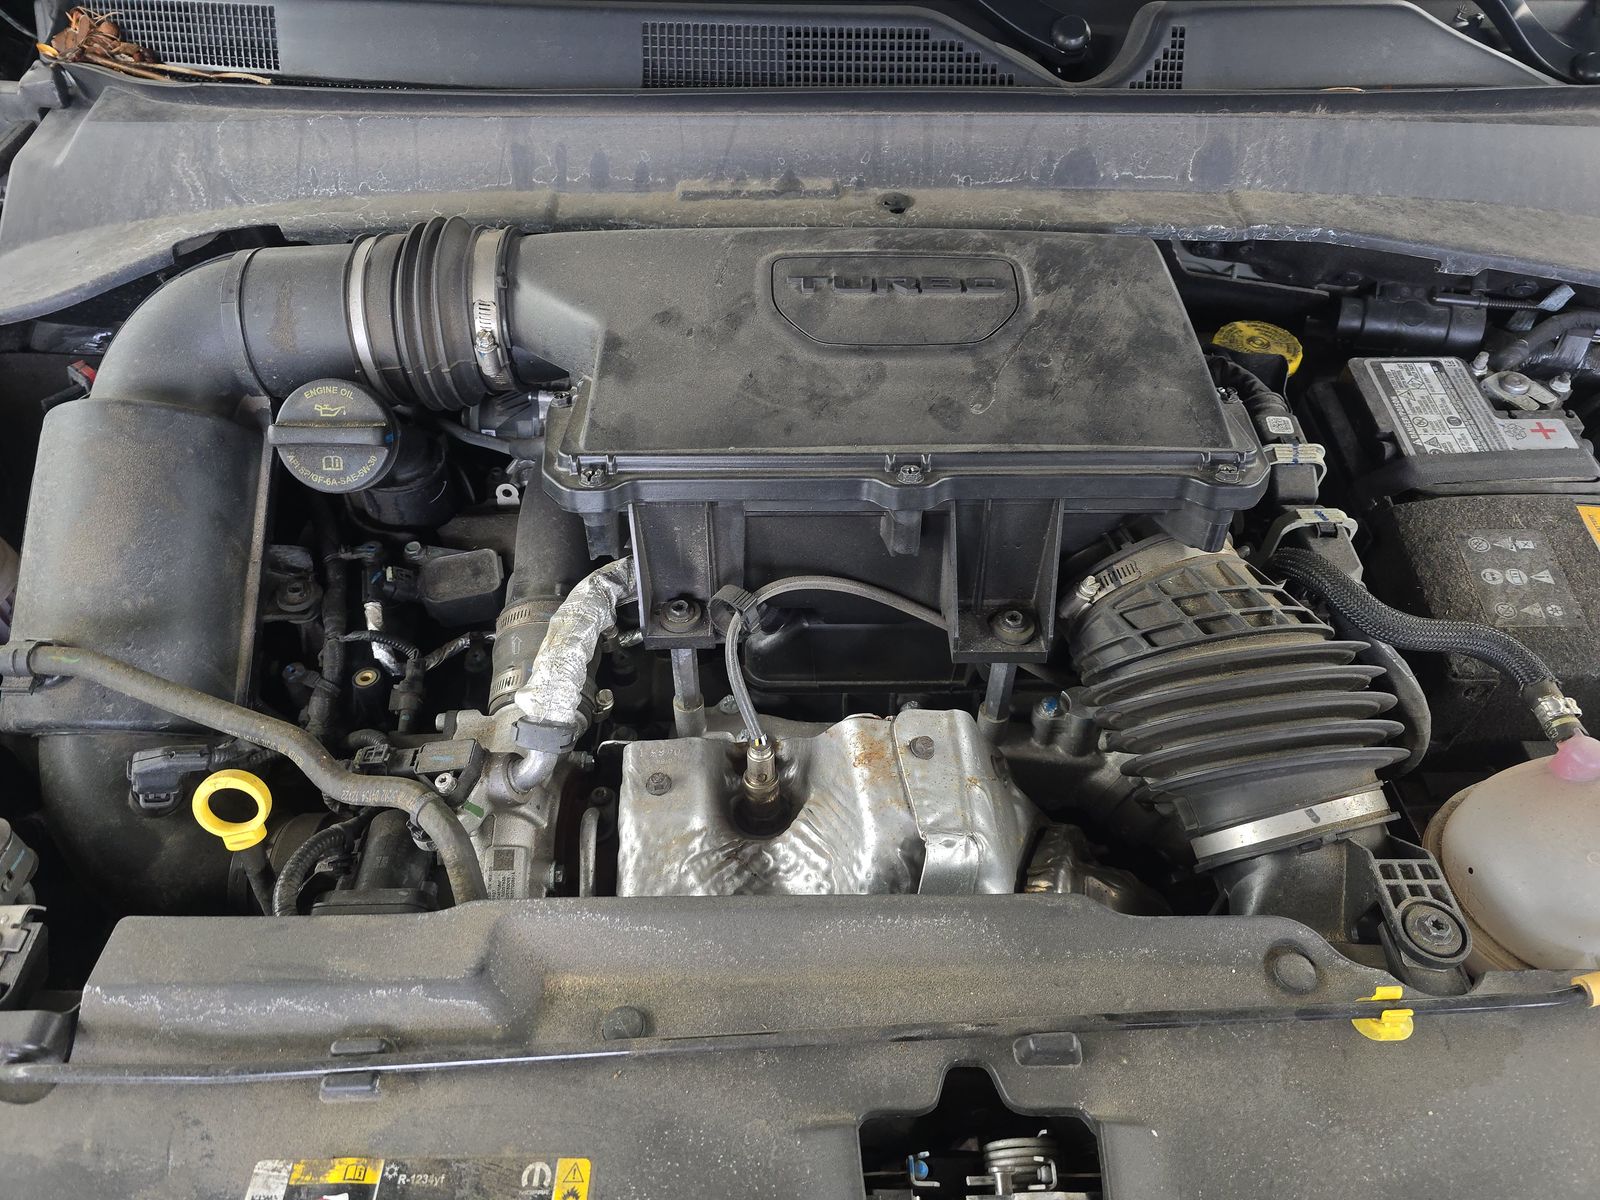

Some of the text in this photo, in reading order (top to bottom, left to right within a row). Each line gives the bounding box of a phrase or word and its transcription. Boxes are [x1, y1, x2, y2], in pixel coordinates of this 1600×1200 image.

[304, 386, 354, 400] ENGINE OIL
[287, 455, 300, 470] API
[397, 1173, 445, 1186] R-1234yf
